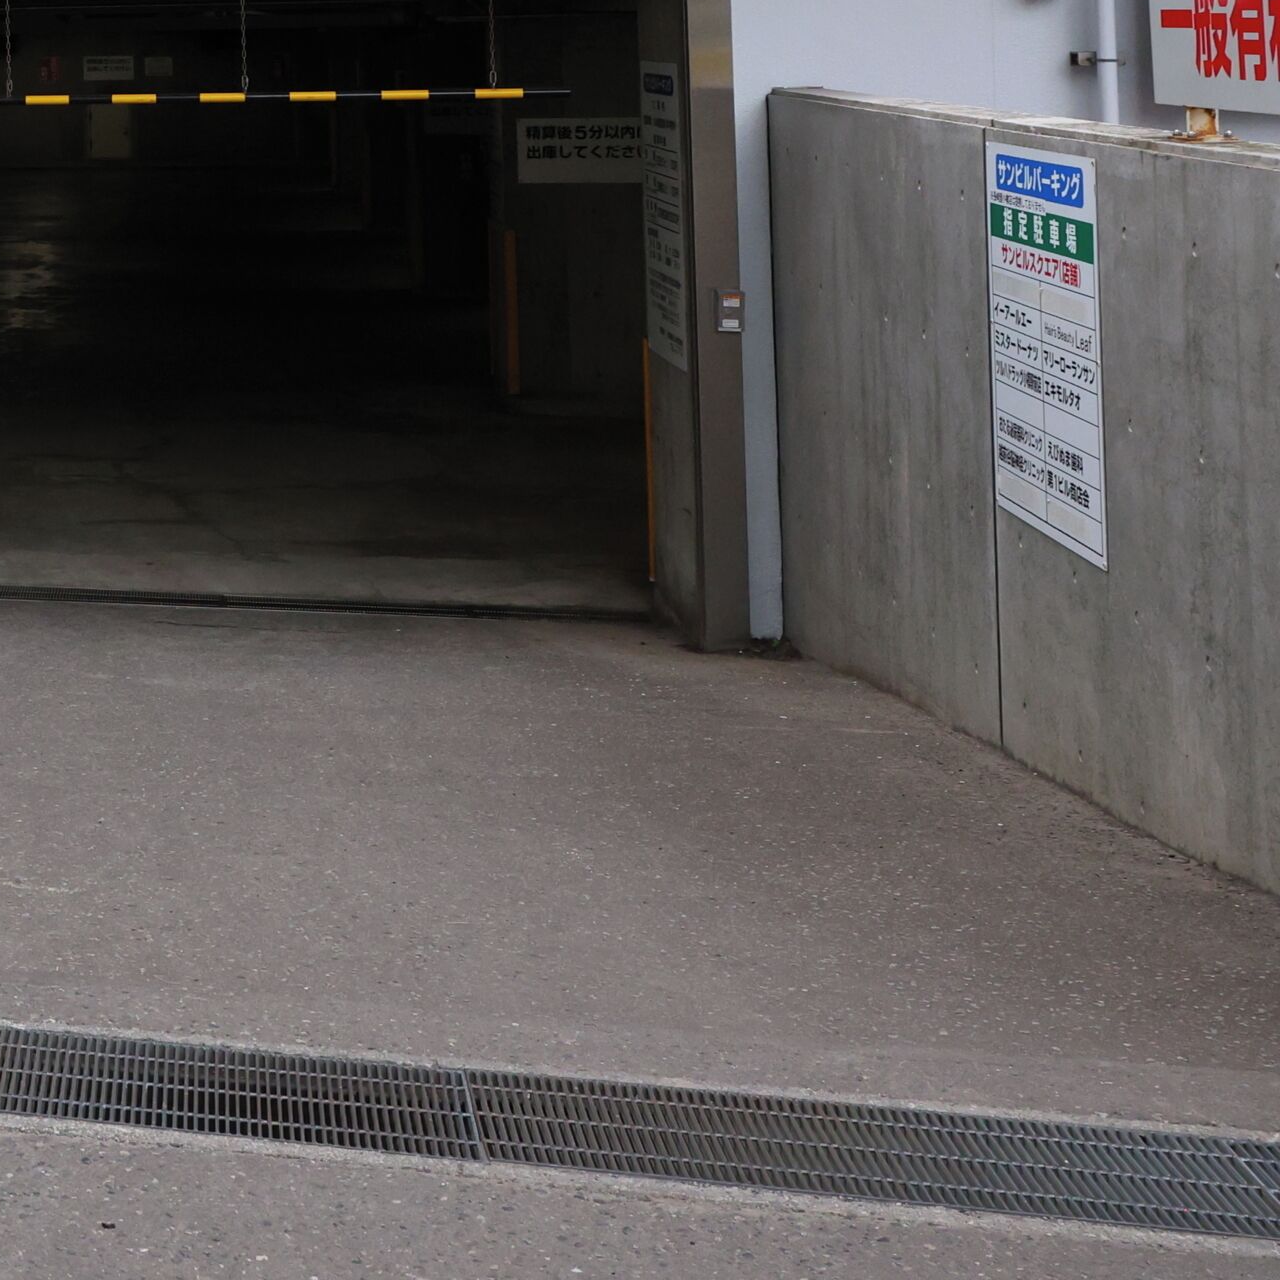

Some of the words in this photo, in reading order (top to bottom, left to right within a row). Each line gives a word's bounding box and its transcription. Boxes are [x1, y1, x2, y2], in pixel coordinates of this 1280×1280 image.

[998, 160, 1081, 200] サンビルパーキング
[1003, 208, 1077, 255] 指定駐車場
